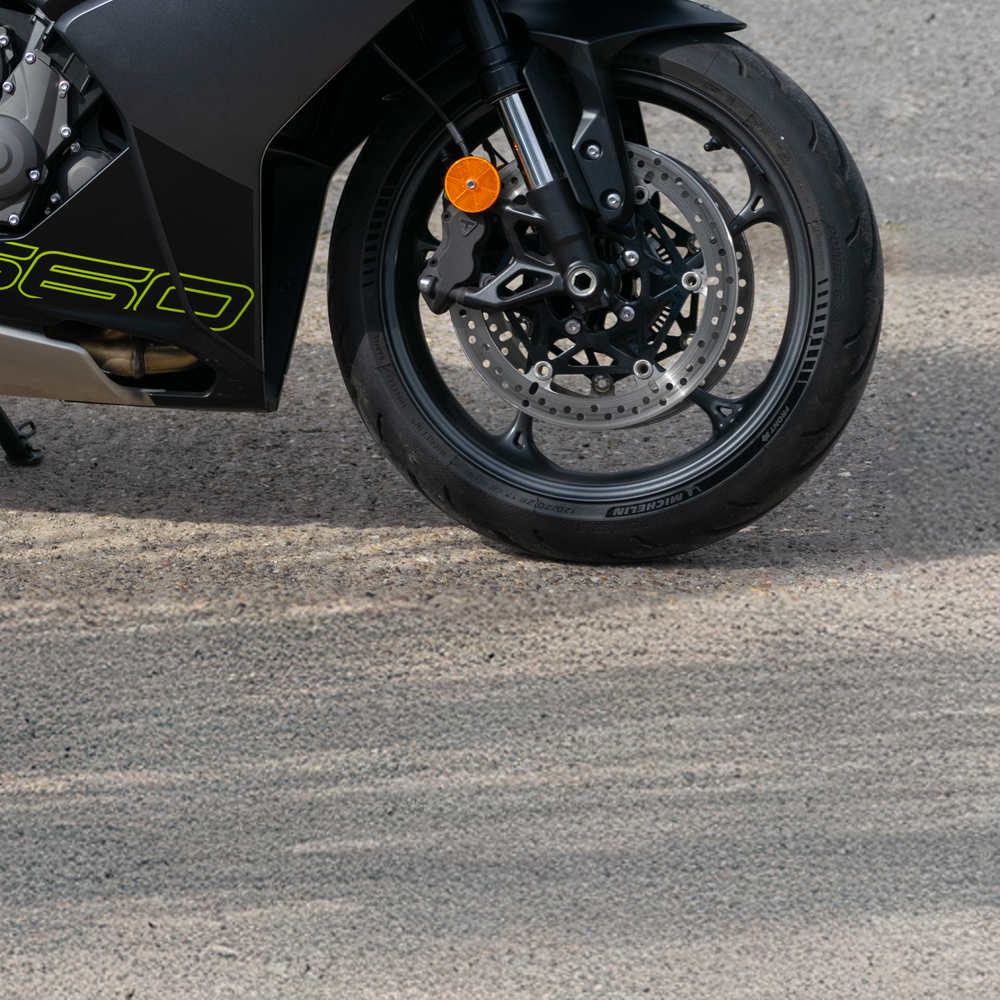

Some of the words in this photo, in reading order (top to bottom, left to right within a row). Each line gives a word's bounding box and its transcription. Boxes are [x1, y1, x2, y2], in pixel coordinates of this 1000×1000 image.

[770, 405, 790, 434] FRONT
[519, 498, 536, 507] ZR
[537, 501, 576, 515] 120/70
[612, 492, 683, 517] MICHELIN
